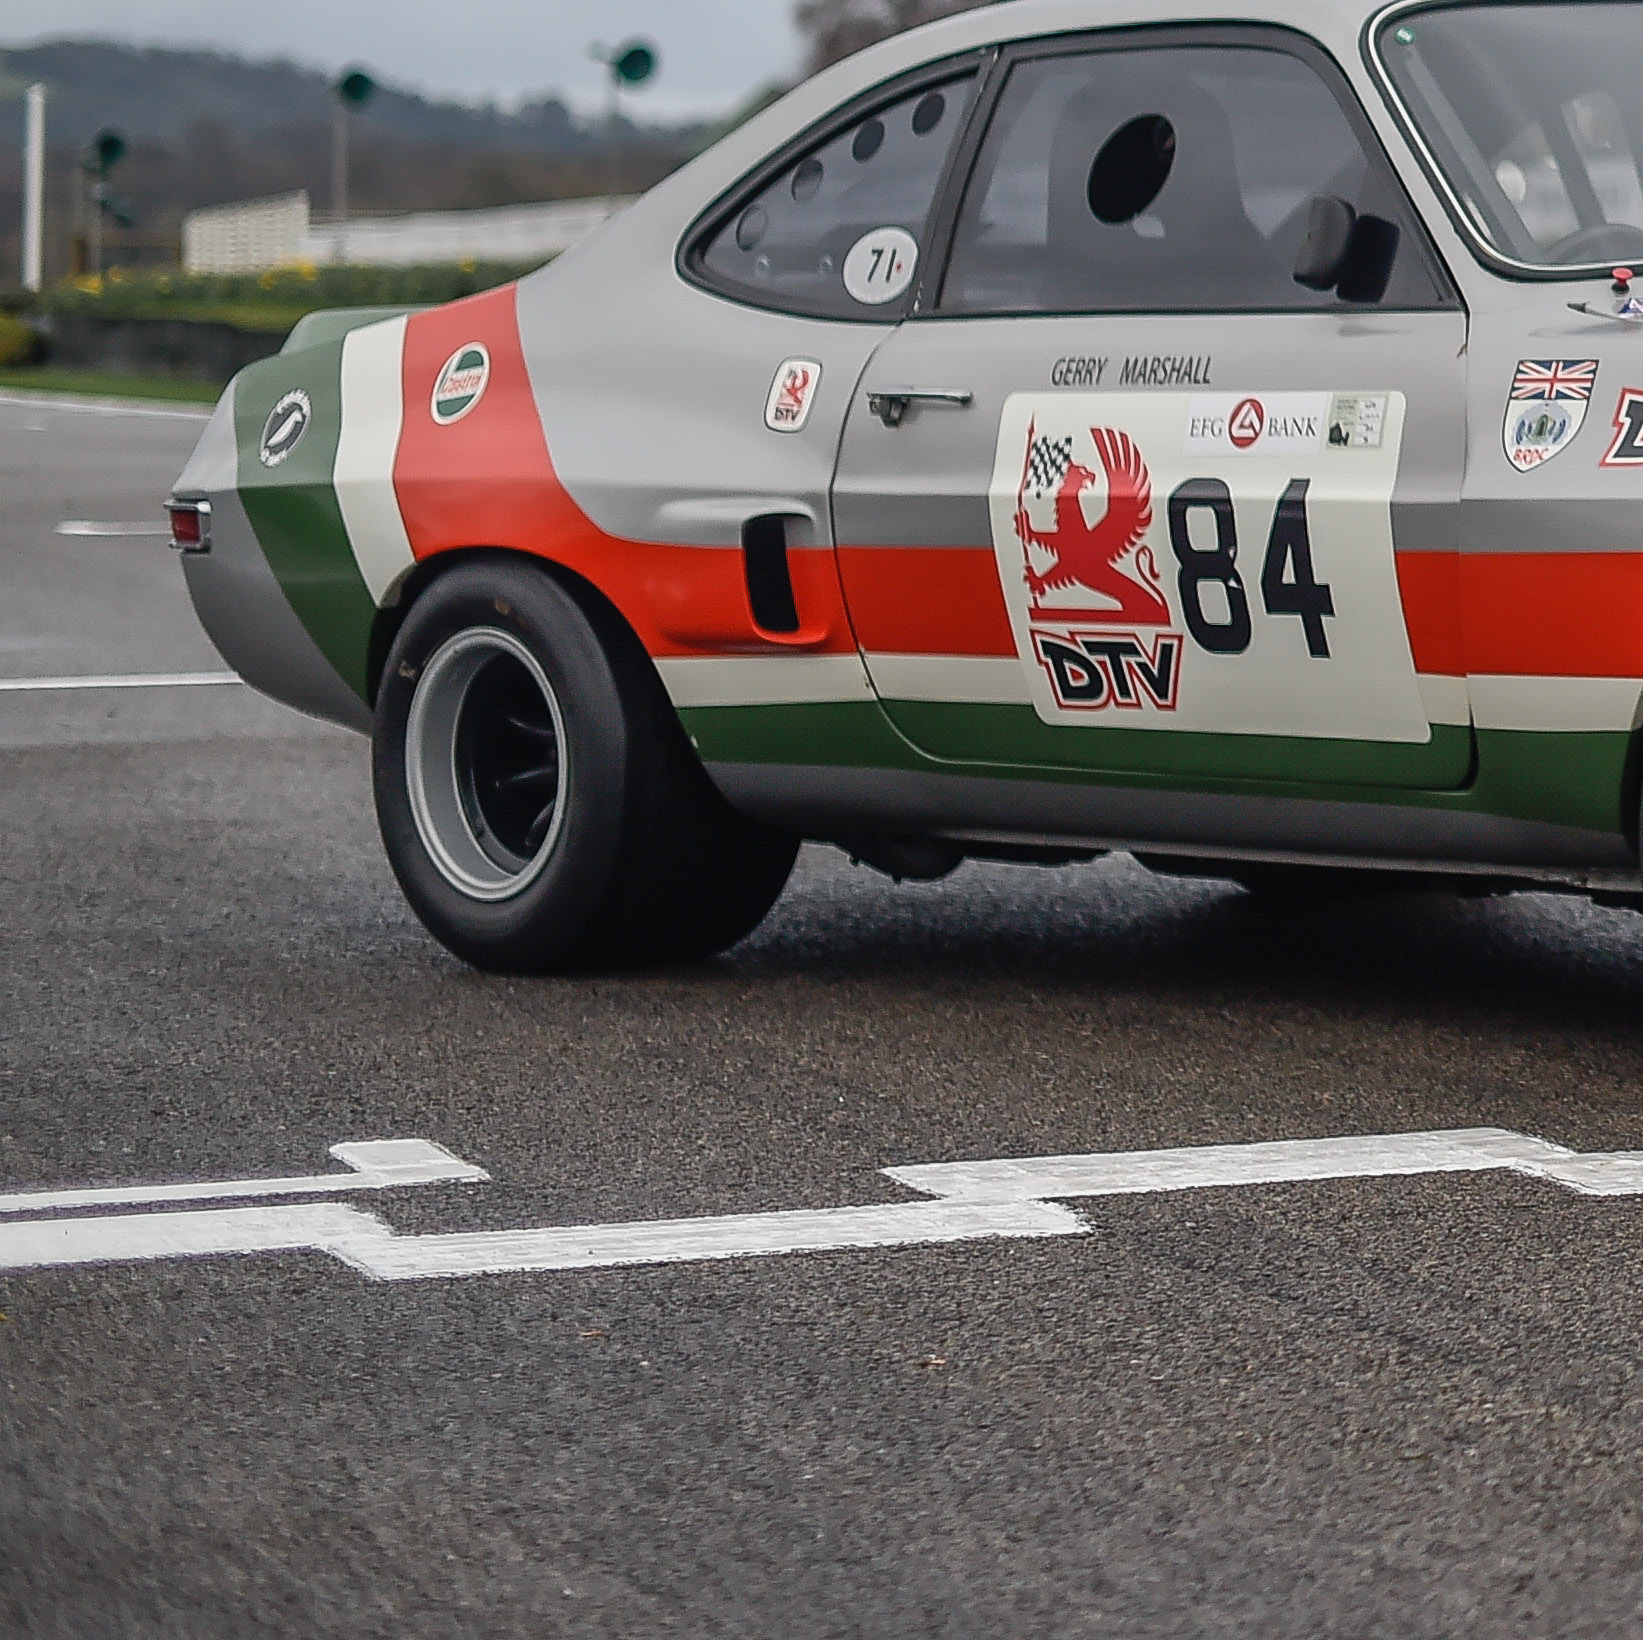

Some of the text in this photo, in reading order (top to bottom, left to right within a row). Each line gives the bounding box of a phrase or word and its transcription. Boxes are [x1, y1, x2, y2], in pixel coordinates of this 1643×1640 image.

[867, 247, 897, 283] 71
[1051, 355, 1211, 387] GERRY MARSHALL
[1190, 415, 1317, 438] EFG BANK
[1167, 477, 1336, 659] 84
[1034, 634, 1179, 705] DTV
